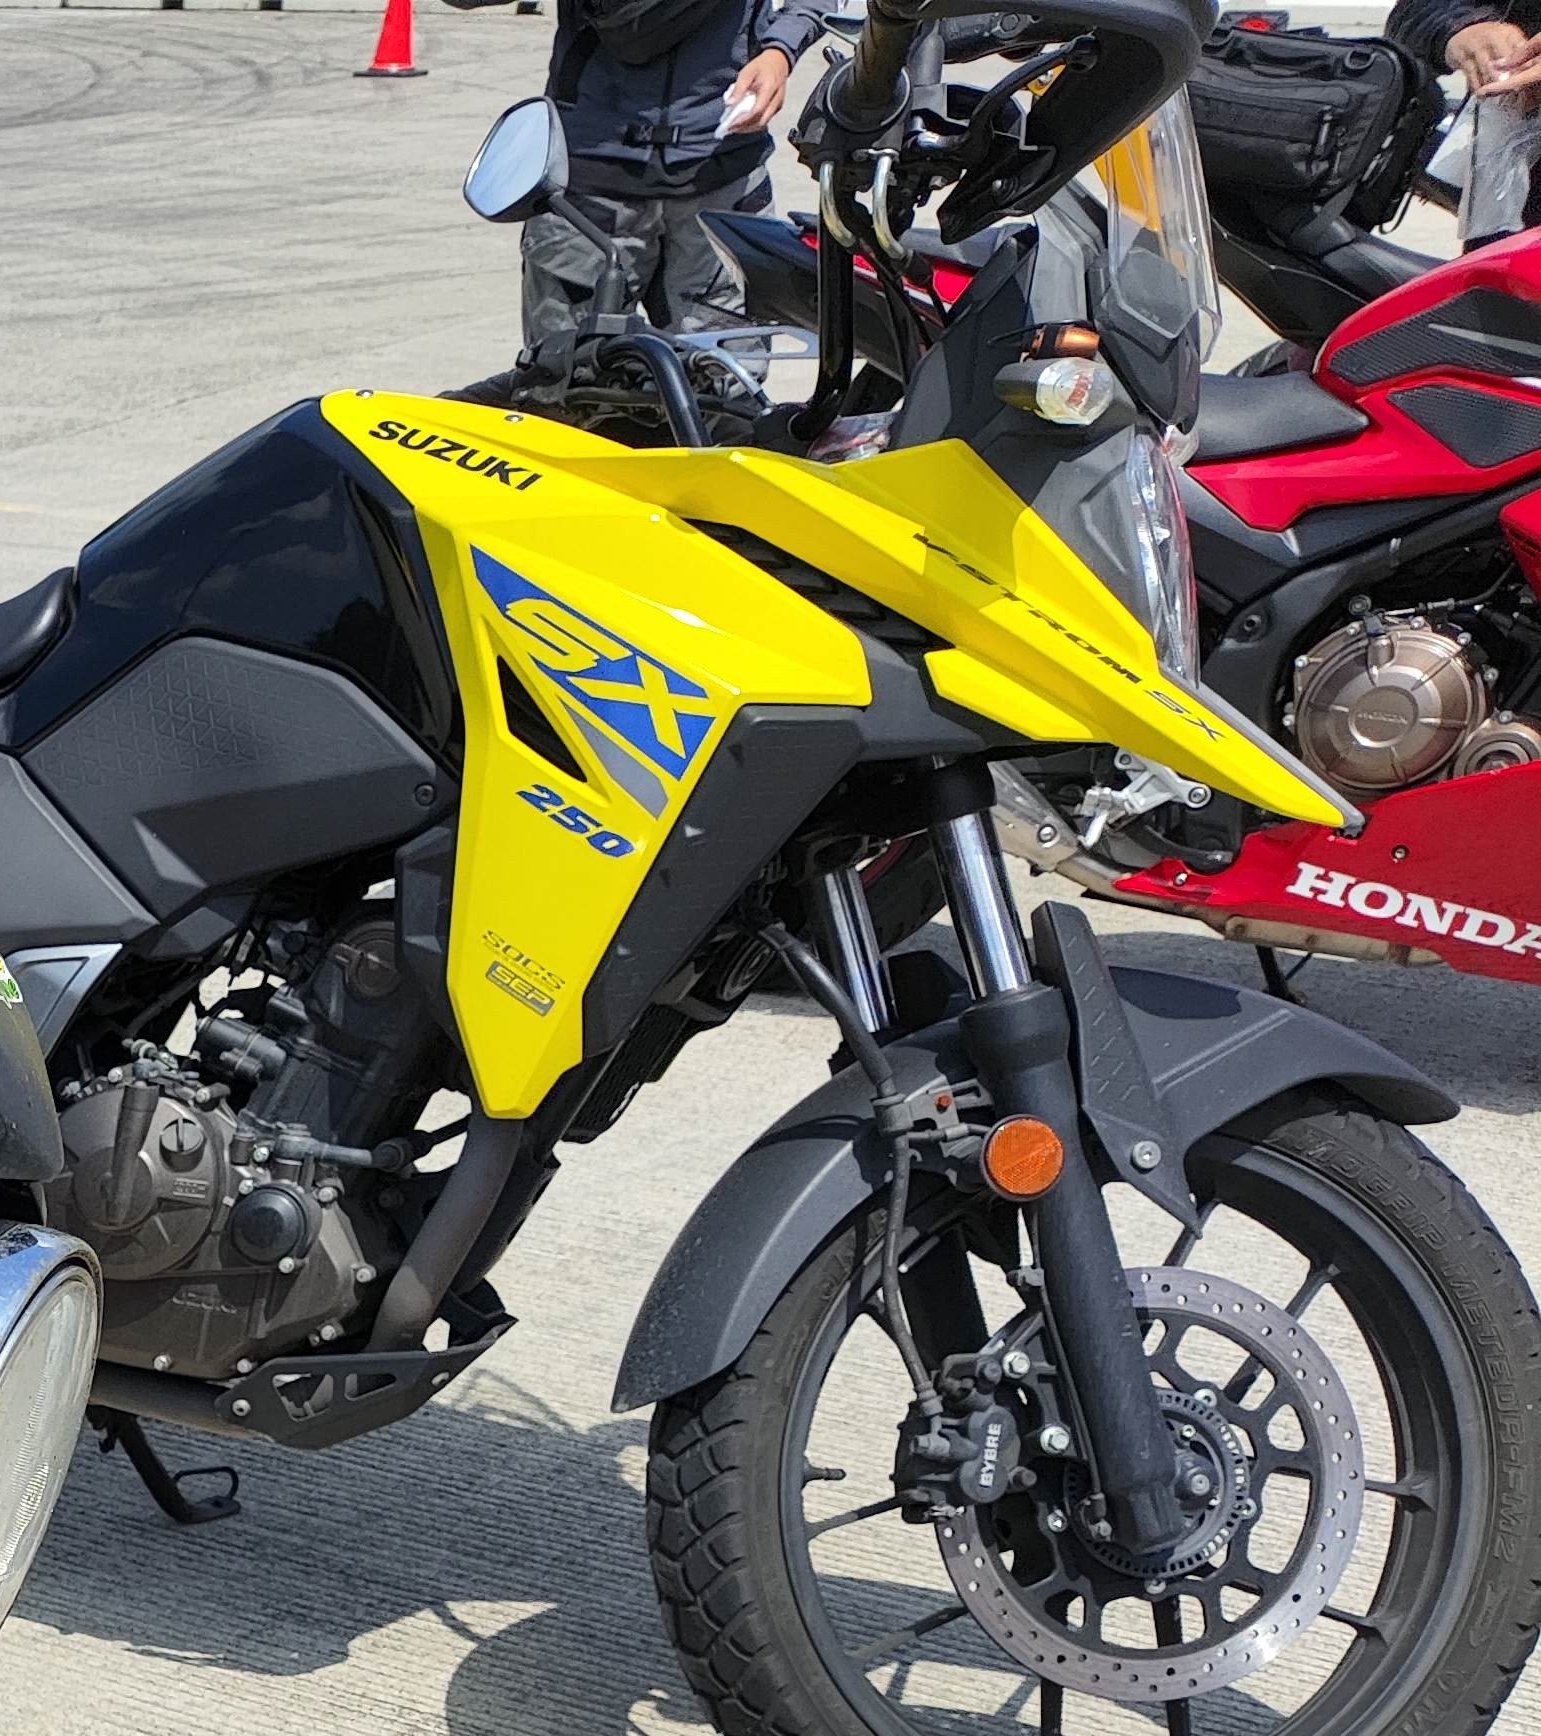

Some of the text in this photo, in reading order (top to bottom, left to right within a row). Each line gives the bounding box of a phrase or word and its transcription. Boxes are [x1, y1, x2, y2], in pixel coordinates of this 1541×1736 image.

[369, 420, 543, 491] SUZUKI
[1150, 688, 1227, 742] SX
[516, 784, 636, 859] 250
[1285, 861, 1541, 960] HONDA
[977, 1423, 1003, 1488] BYBRE
